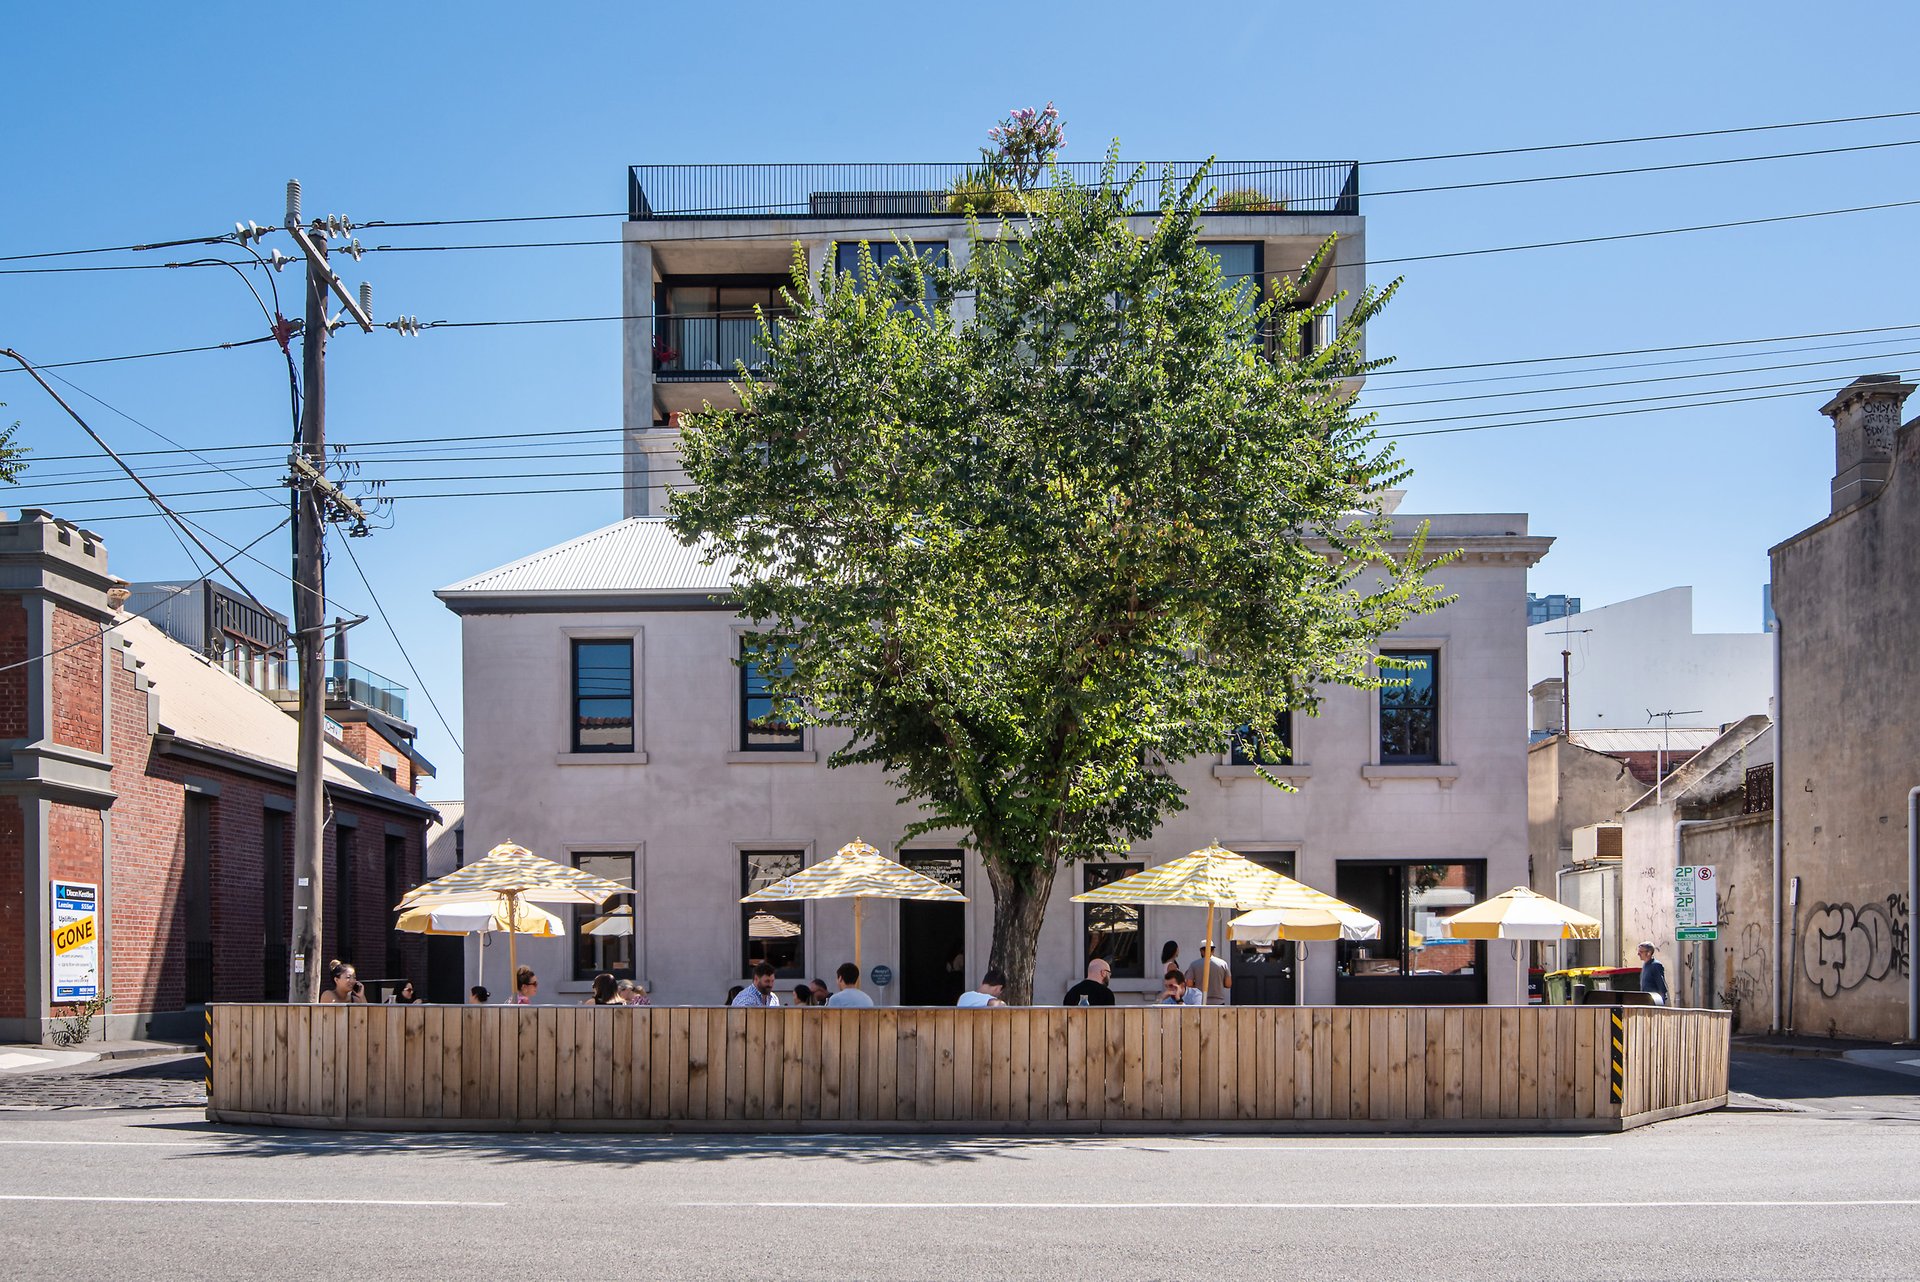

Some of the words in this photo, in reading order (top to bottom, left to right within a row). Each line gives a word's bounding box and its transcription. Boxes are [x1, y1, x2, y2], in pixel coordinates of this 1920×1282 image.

[1676, 867, 1692, 877] 2P
[1677, 897, 1693, 907] 2P
[57, 921, 92, 949] GONE
